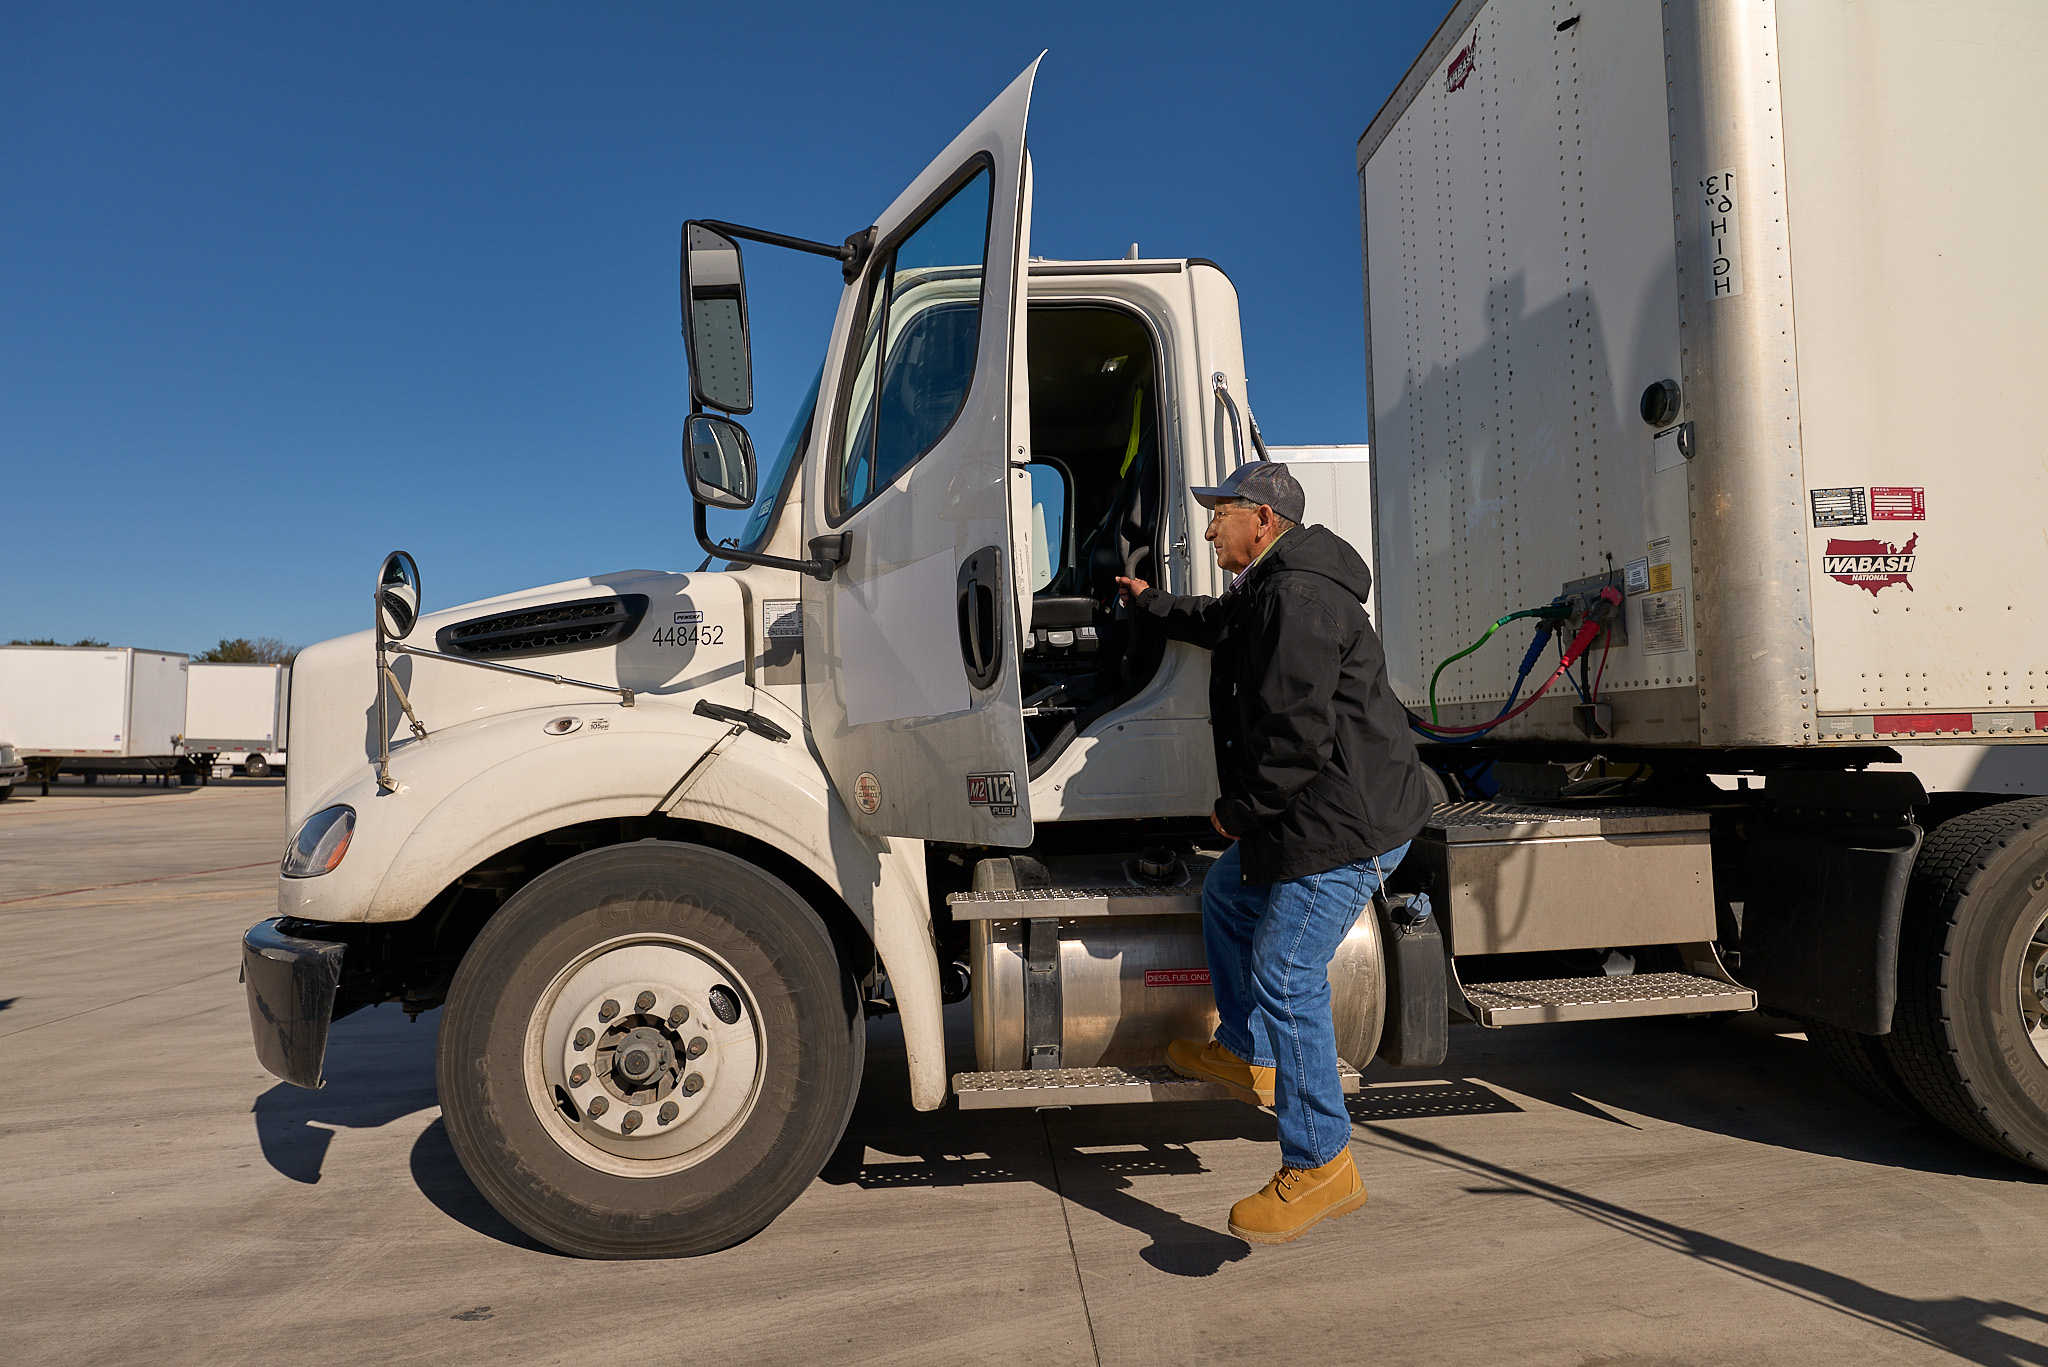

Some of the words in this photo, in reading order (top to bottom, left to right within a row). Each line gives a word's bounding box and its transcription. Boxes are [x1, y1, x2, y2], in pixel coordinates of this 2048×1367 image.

[1824, 556, 1915, 573] WABASH
[652, 625, 724, 647] 448452
[970, 781, 985, 798] M2
[987, 776, 1012, 802] 112
[992, 806, 1011, 815] PLUS
[1190, 973, 1210, 981] ONLY
